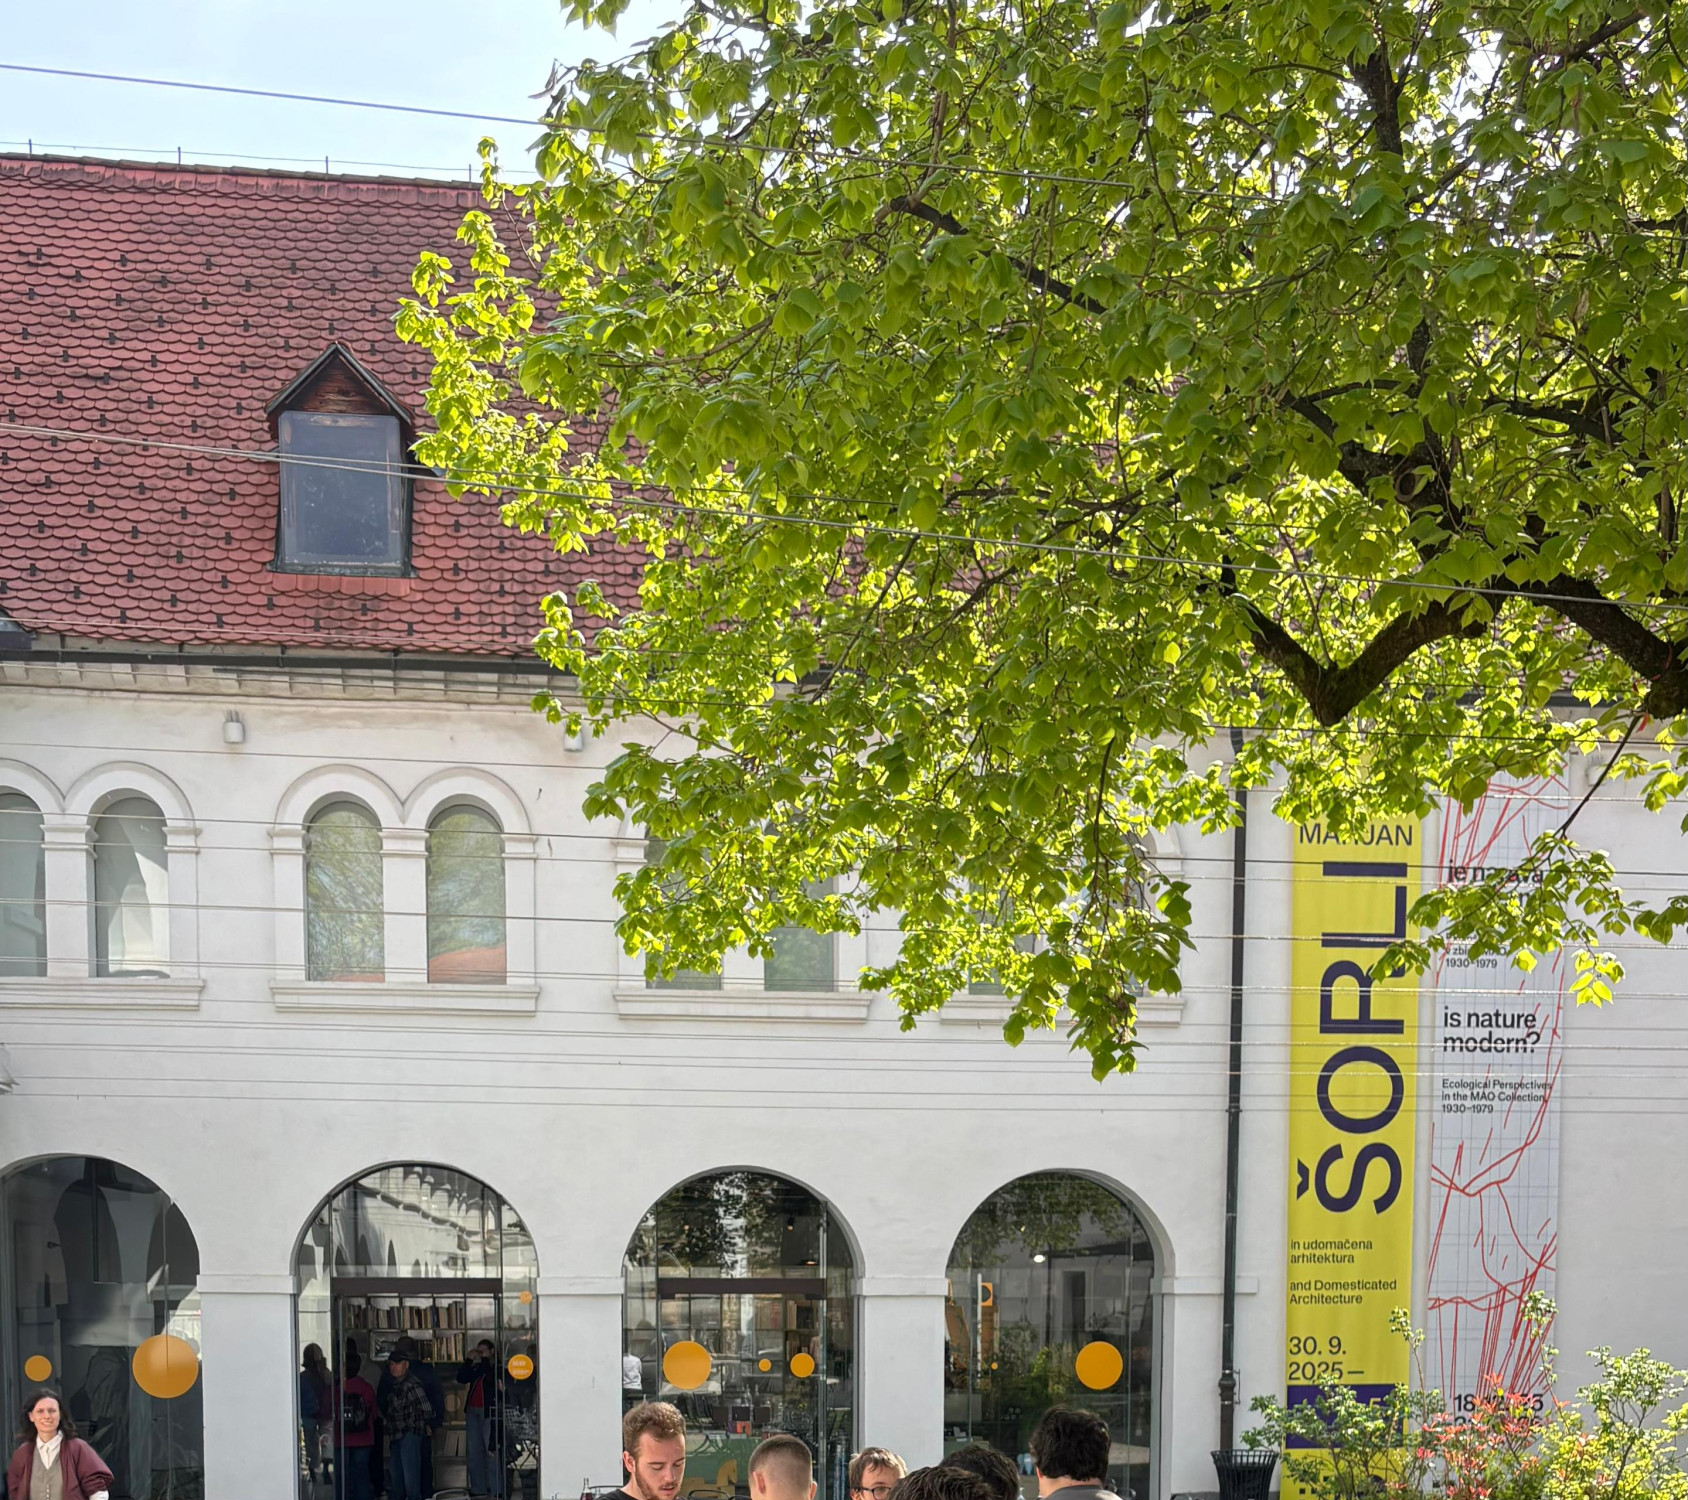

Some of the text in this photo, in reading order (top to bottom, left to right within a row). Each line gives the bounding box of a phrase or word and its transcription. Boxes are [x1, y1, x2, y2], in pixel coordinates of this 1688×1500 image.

[1299, 822, 1413, 846] MAJAN
[1444, 1005, 1537, 1029] is nature
[1296, 860, 1408, 1215] ŠORLI
[1443, 1030, 1541, 1054] modern?
[1442, 1079, 1552, 1091] Ecological Perspectives
[1442, 1091, 1545, 1103] in the MAO Collection
[1291, 1239, 1373, 1251] in udomačena
[1290, 1253, 1355, 1264] arhitektura
[1289, 1279, 1398, 1291] and Domesticated
[1289, 1293, 1363, 1305] Architecture
[1289, 1336, 1347, 1356] 30. 9.
